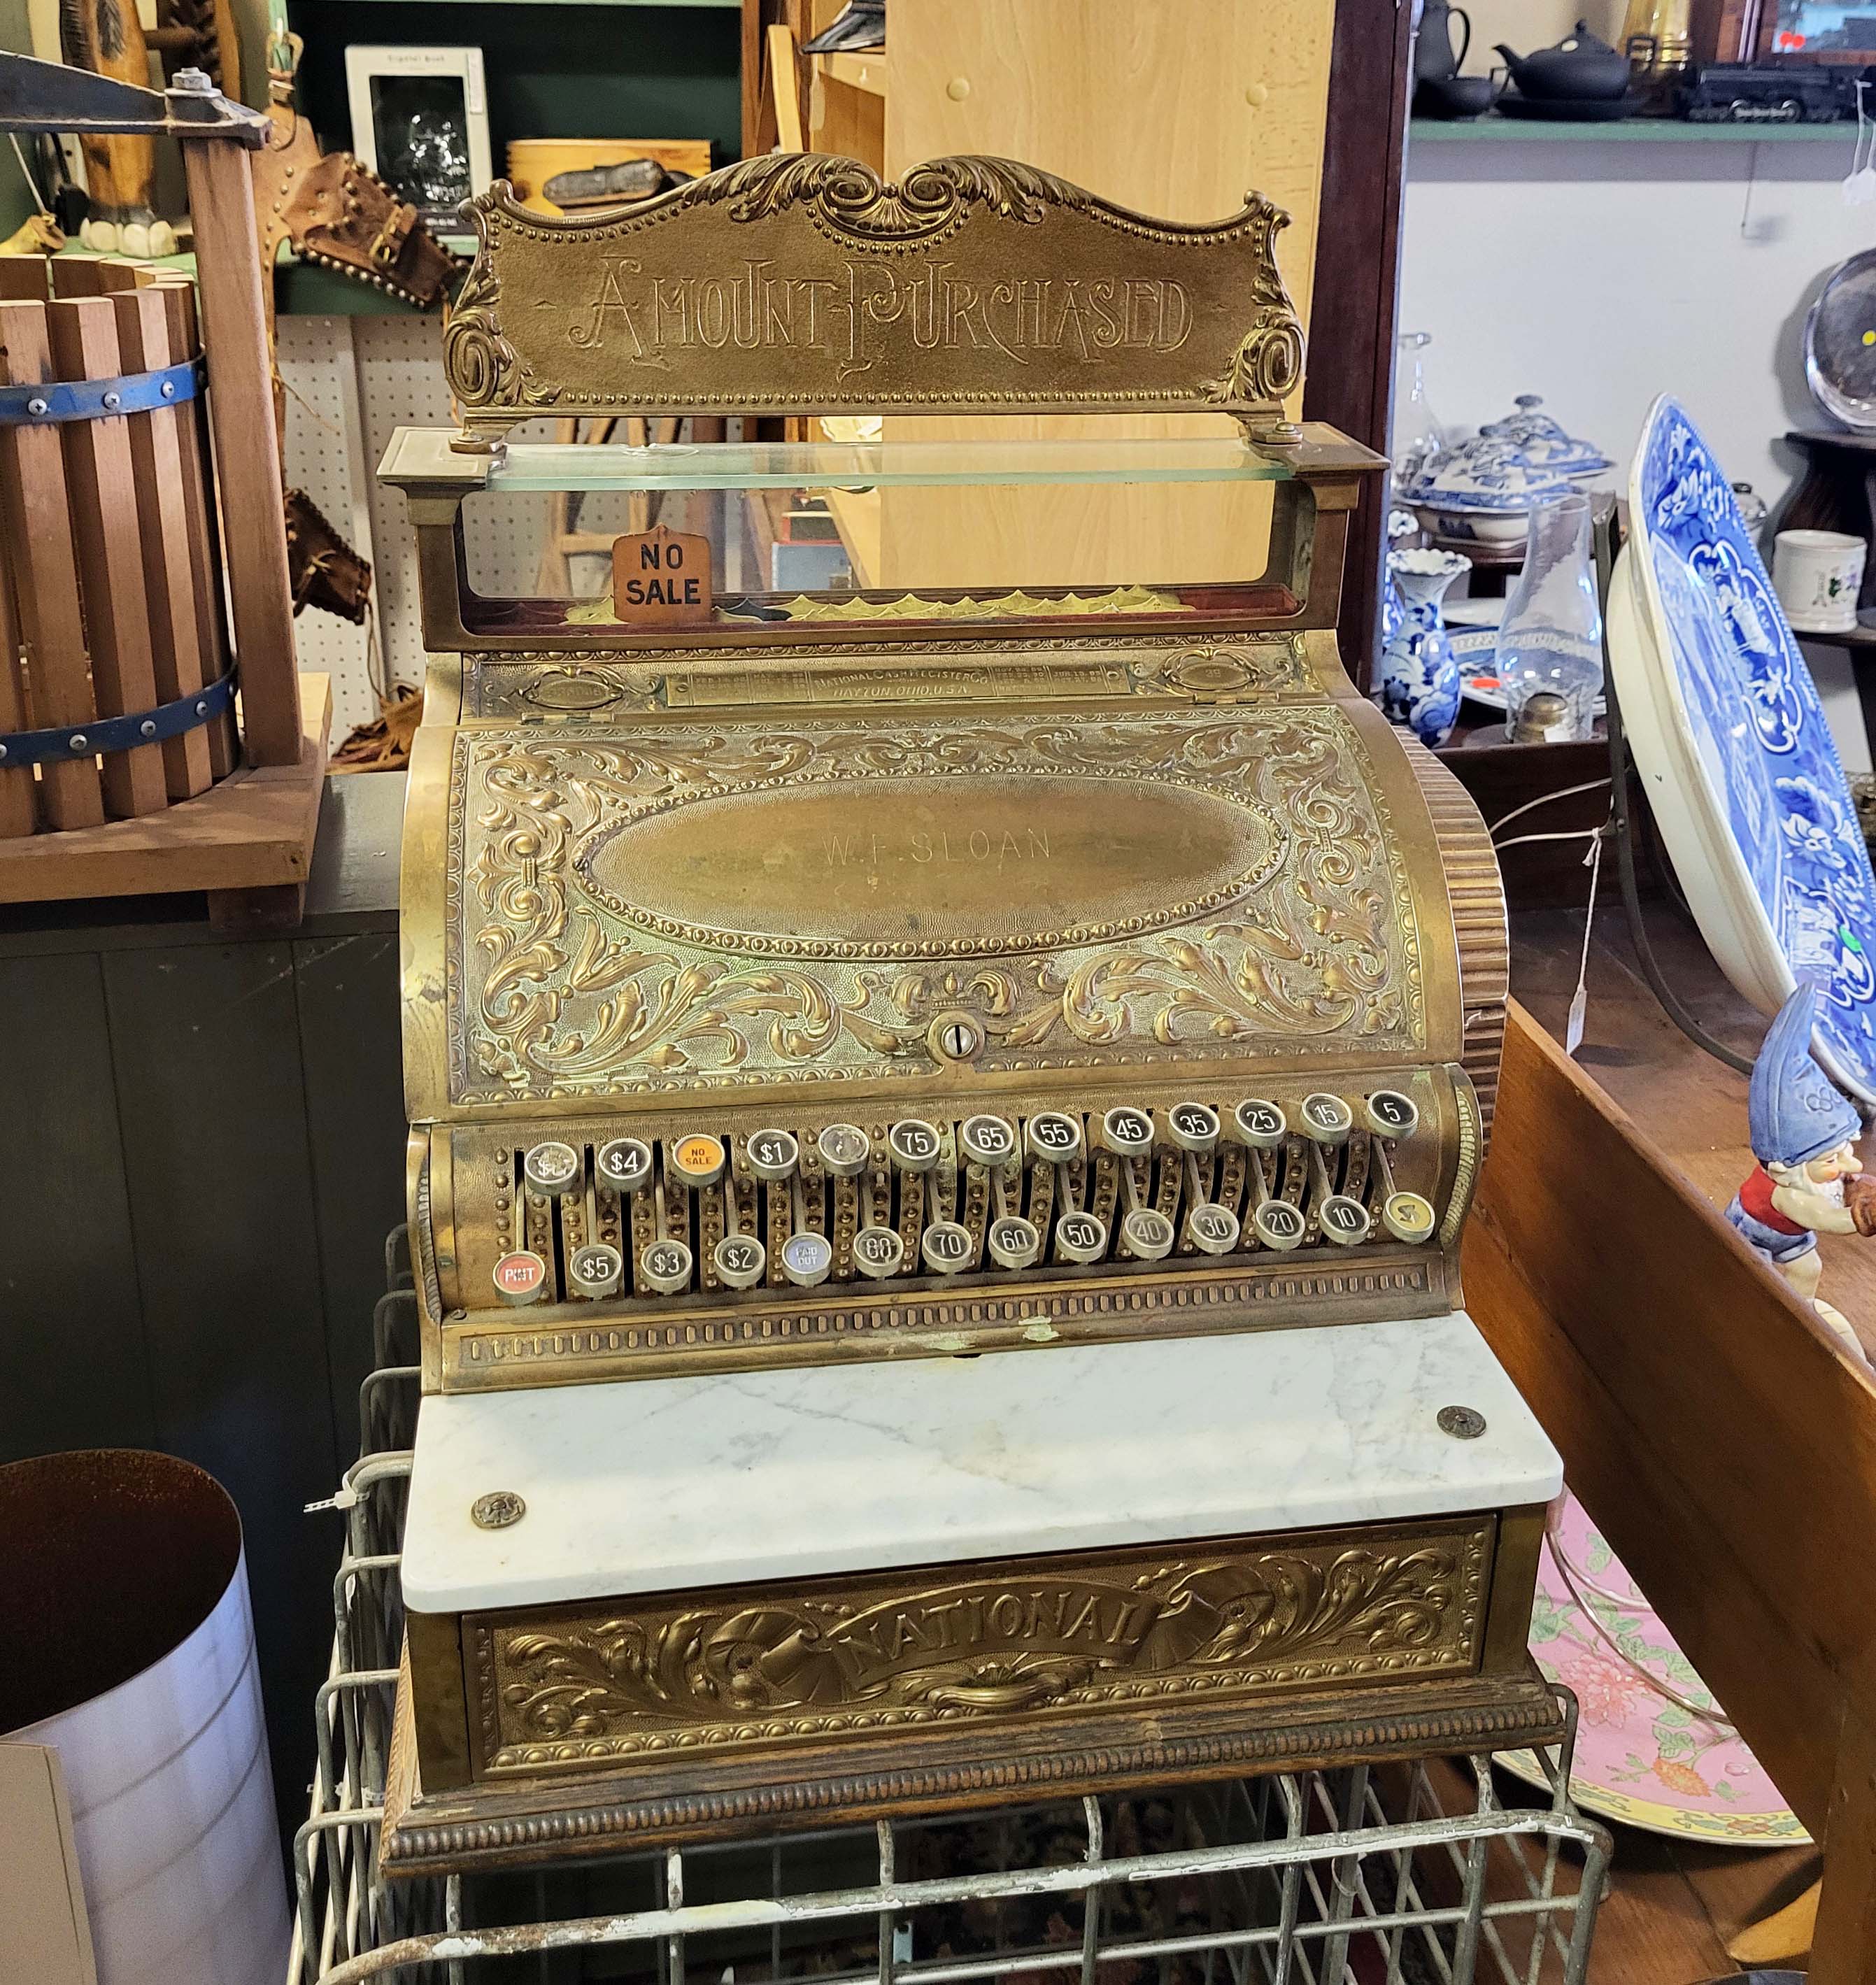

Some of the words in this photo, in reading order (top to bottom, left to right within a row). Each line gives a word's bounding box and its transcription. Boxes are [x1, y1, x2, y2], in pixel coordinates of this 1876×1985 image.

[568, 255, 841, 372] AMOUNT
[836, 259, 1193, 384] PURCHASED
[641, 543, 683, 570] NO
[626, 578, 701, 605] SALE
[911, 828, 1050, 863] SLOAN
[1246, 1109, 1274, 1131] 25
[1314, 1104, 1340, 1125] 15
[1386, 1102, 1401, 1123] 5
[1040, 1123, 1068, 1144] 55
[1116, 1118, 1142, 1140] 45
[1179, 1113, 1209, 1135] 35
[902, 1132, 929, 1154] 75
[977, 1127, 1004, 1148] 65
[611, 1151, 638, 1173] $4
[685, 1156, 712, 1165] SALE
[691, 1148, 705, 1157] NO
[760, 1141, 783, 1163] $1
[1200, 1215, 1228, 1237] 30
[1267, 1211, 1294, 1232] 20
[1331, 1207, 1356, 1228] 10
[1002, 1229, 1028, 1251] 60
[1067, 1224, 1095, 1246] 50
[1136, 1218, 1160, 1241] 40
[936, 1233, 961, 1255] 70
[583, 1255, 609, 1279] $5
[654, 1251, 681, 1274] $3
[727, 1246, 753, 1269] $2
[838, 1591, 1142, 1675] NATIONAL
